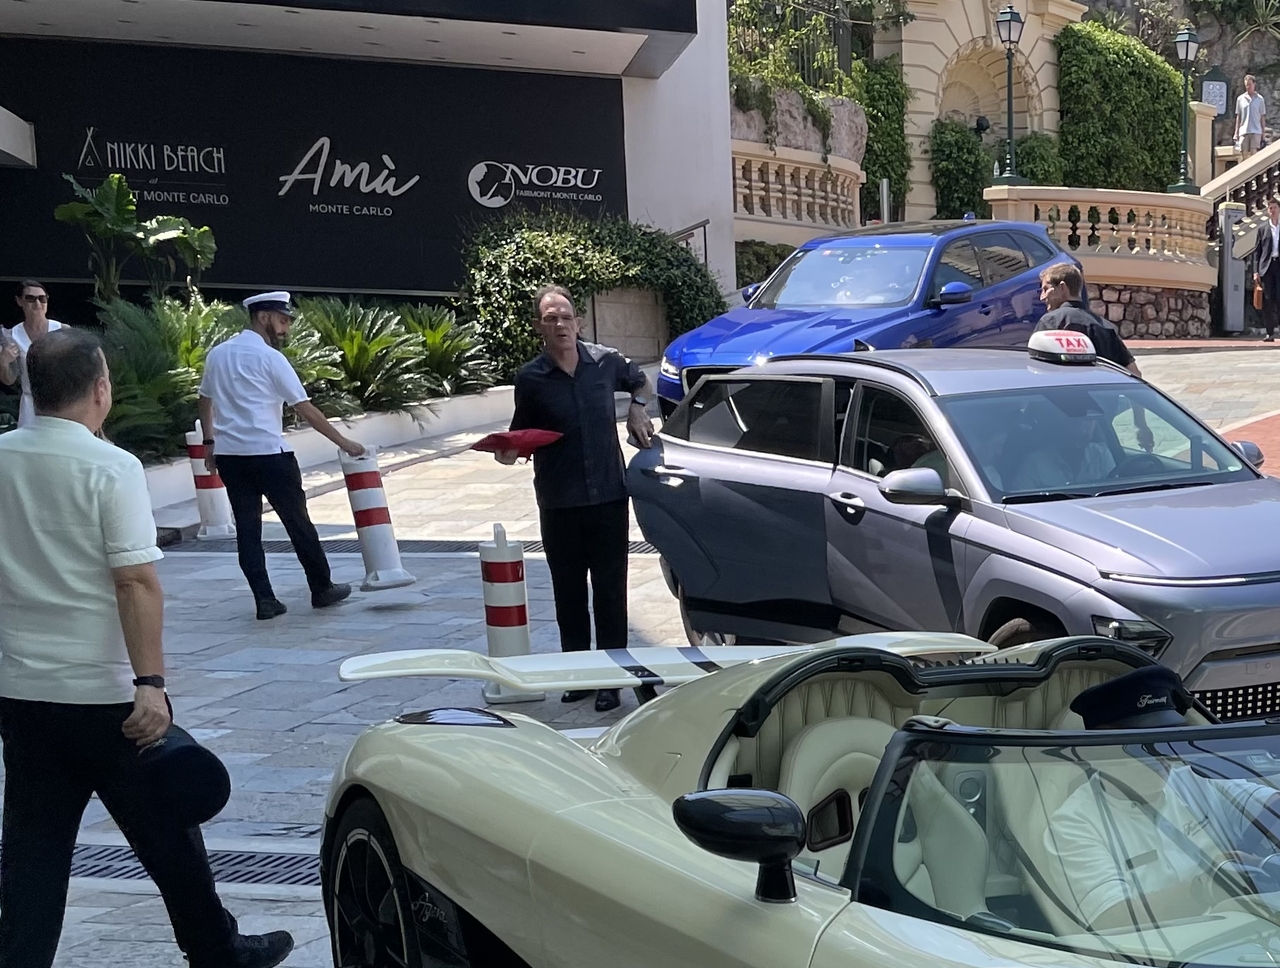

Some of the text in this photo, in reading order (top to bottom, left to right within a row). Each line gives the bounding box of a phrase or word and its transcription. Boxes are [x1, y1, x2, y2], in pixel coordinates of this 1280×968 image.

[106, 141, 225, 174] NIKKI BEACH
[278, 136, 420, 196] Amù
[501, 162, 603, 189] NOBU
[143, 190, 187, 202] MONTE
[189, 192, 229, 205] CARLO
[516, 189, 602, 201] FAIRMONT MONTE CARLO
[309, 203, 393, 217] MONTE CARLO
[1055, 338, 1088, 349] TAXI
